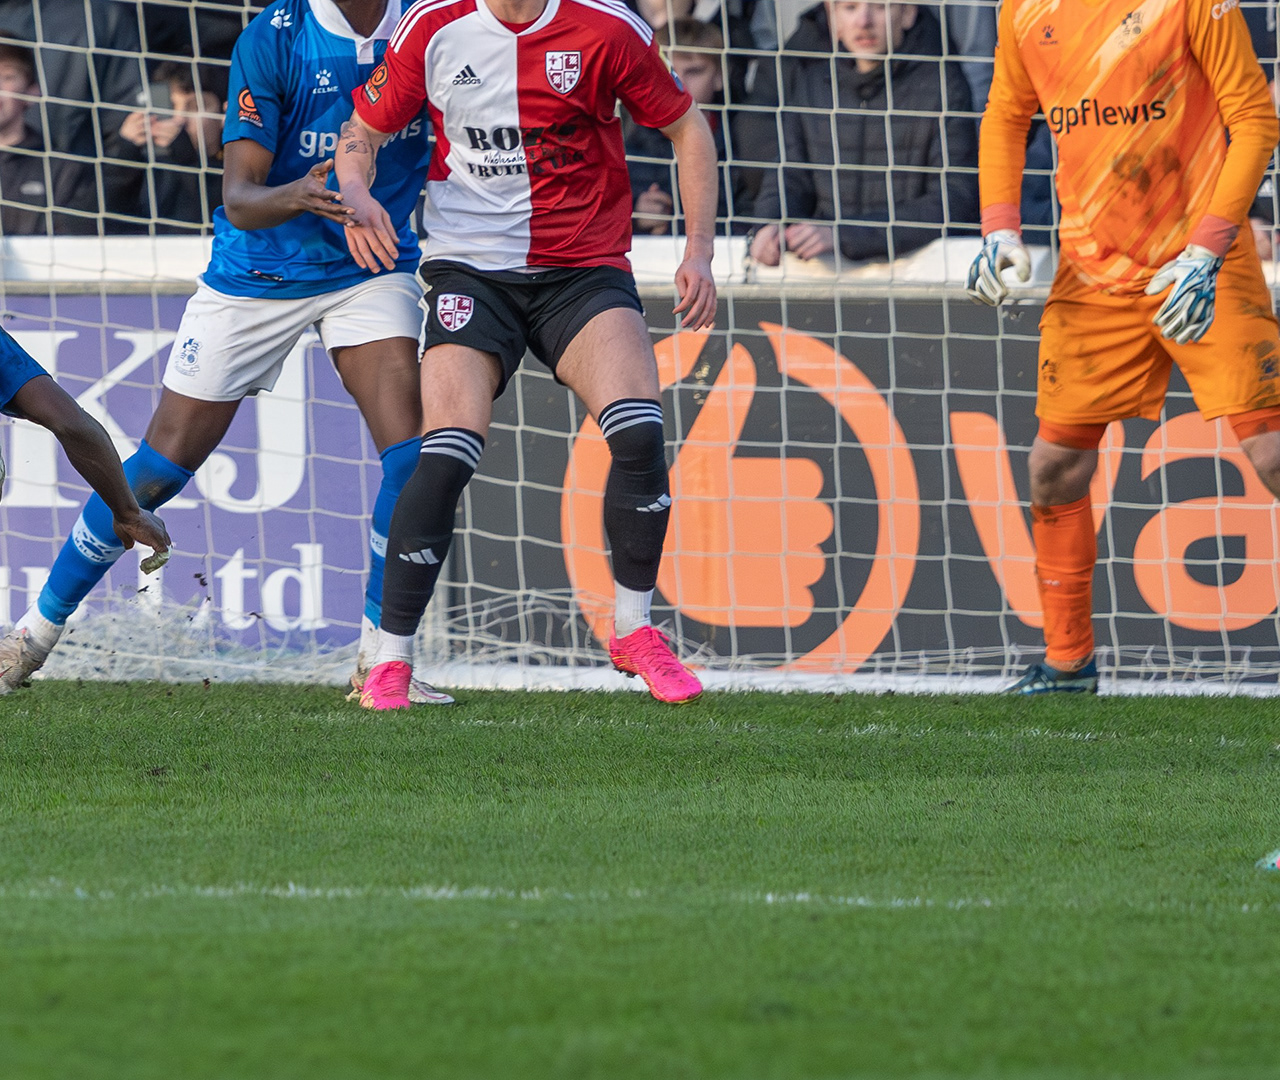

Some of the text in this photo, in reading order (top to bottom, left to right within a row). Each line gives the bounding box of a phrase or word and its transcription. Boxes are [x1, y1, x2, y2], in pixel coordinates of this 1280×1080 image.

[452, 78, 481, 86] adidas
[1050, 98, 1167, 134] gpflewis
[467, 163, 525, 178] FRUIT
